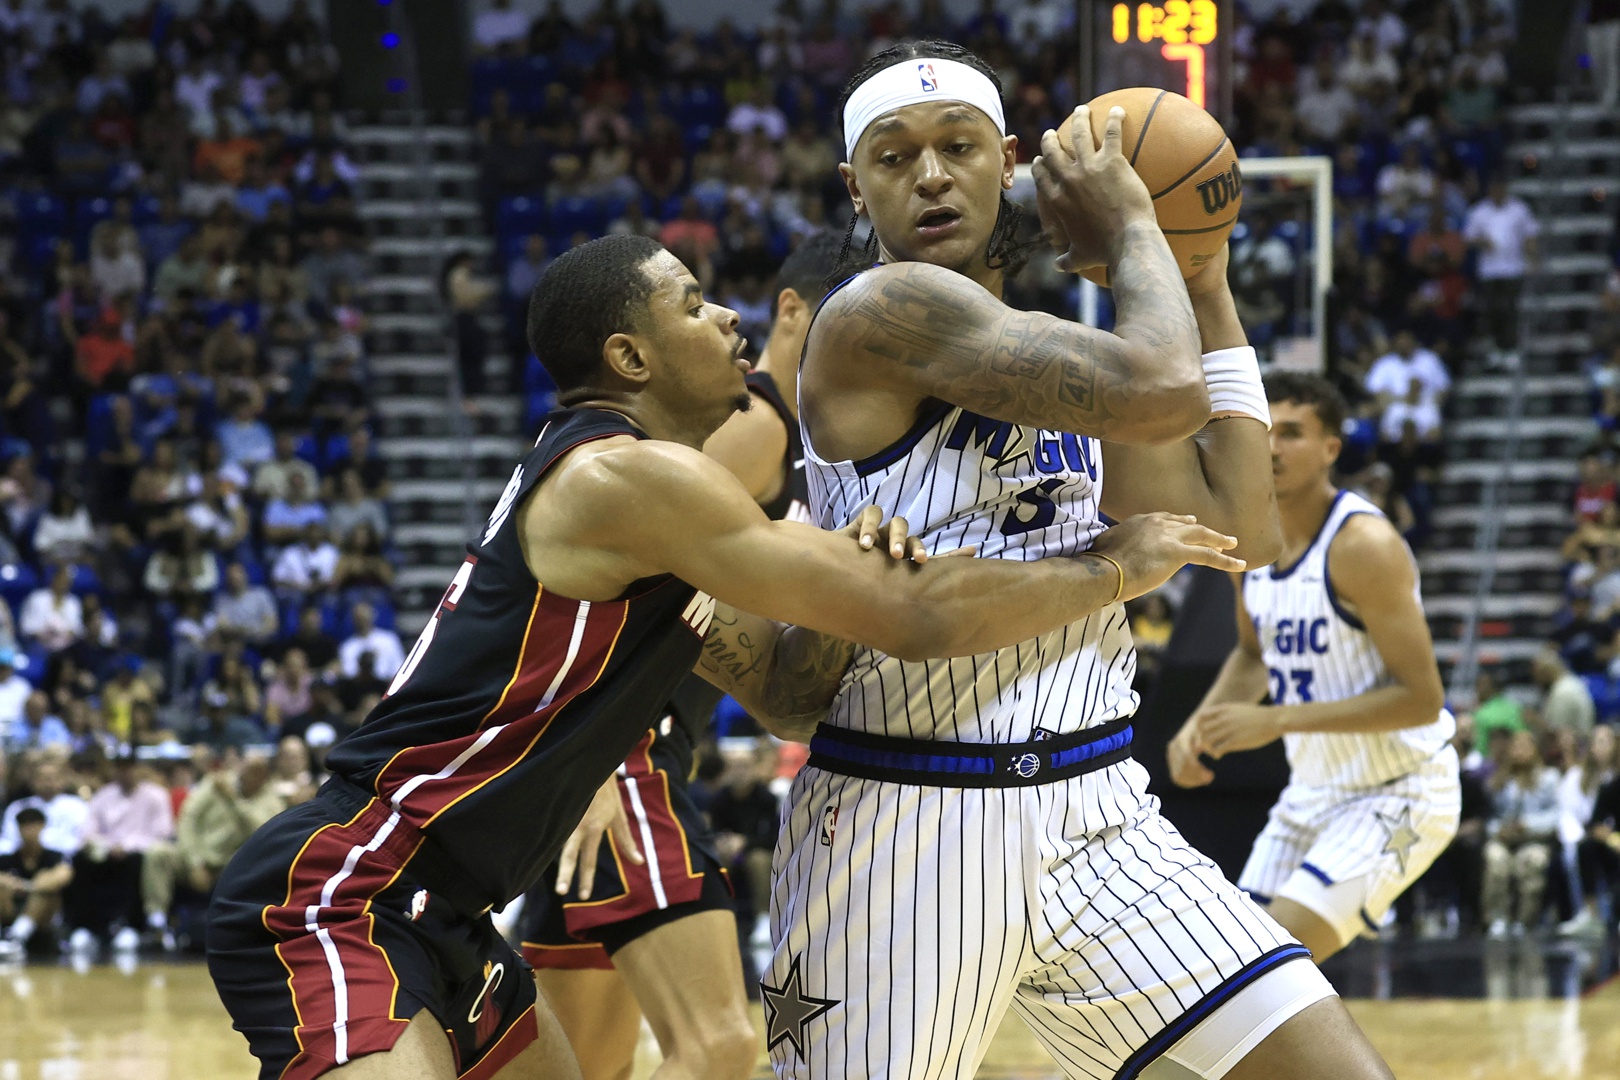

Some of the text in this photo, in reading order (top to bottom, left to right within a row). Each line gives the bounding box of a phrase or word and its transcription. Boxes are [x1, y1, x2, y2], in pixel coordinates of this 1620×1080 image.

[1112, 0, 1217, 44] 11:23
[1161, 43, 1205, 109] 7
[1254, 616, 1328, 655] GIC
